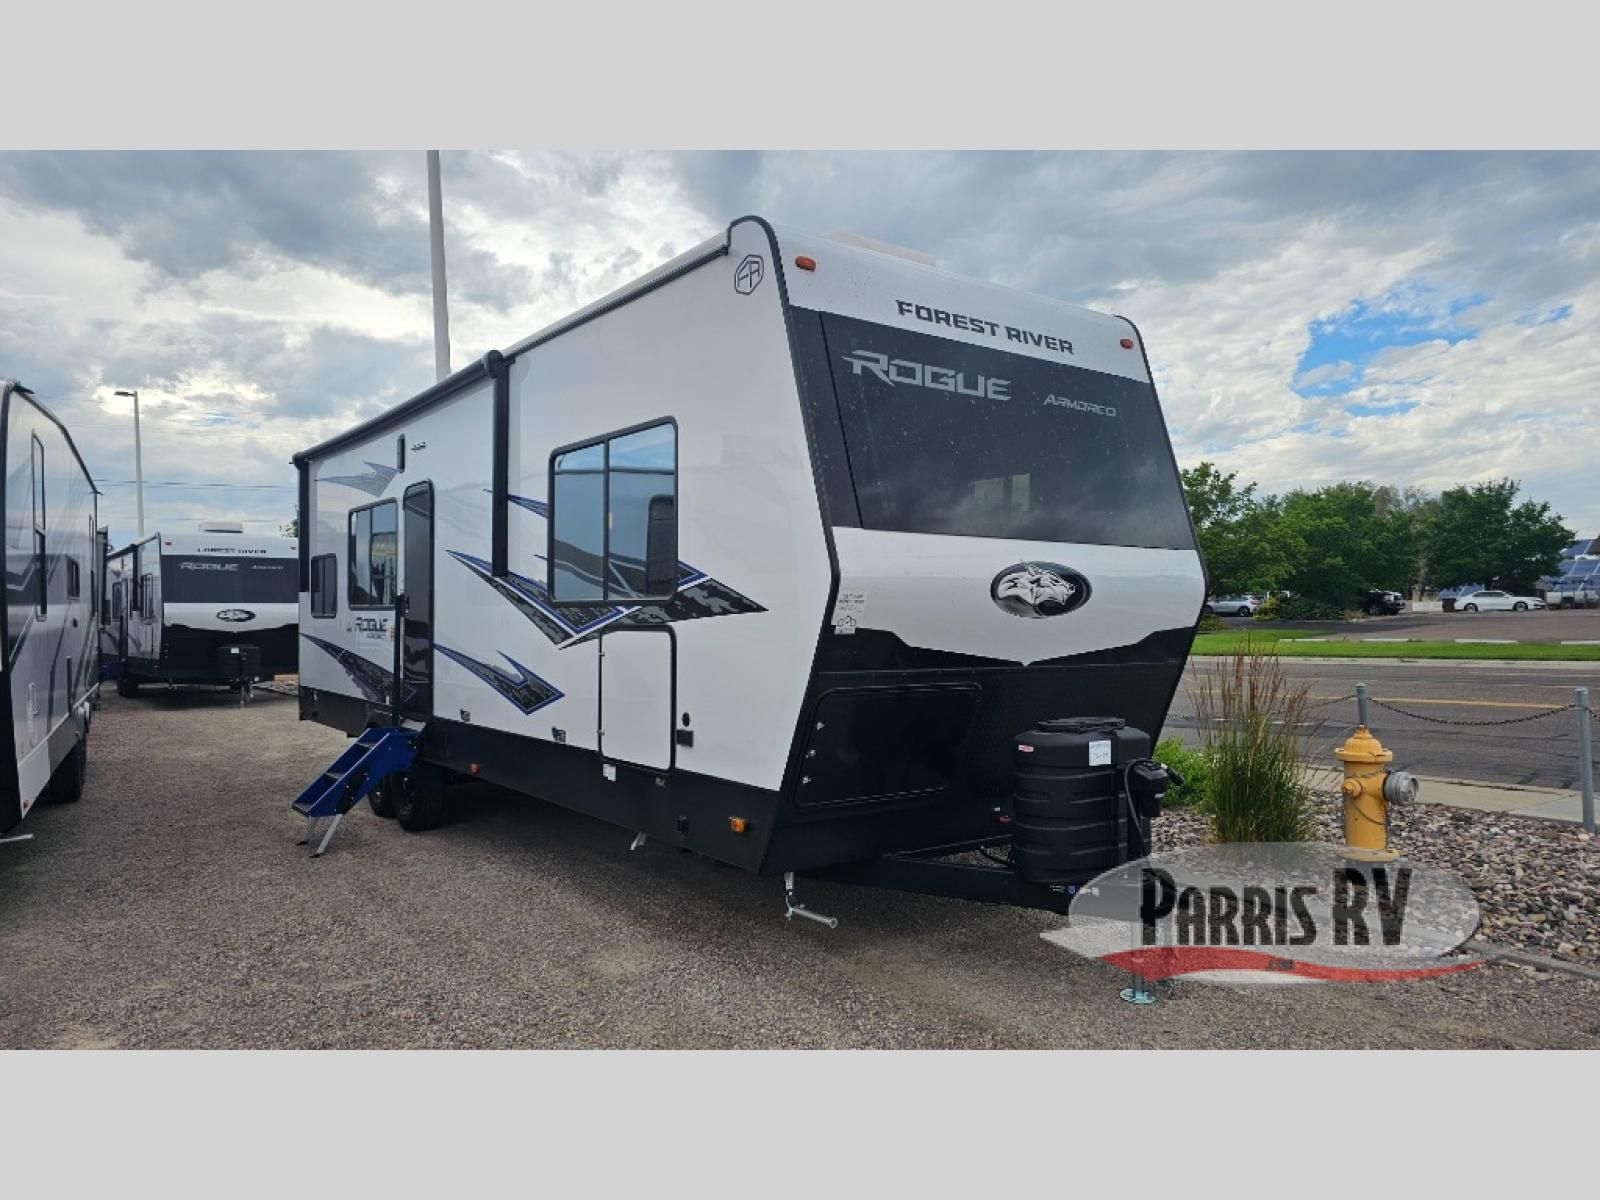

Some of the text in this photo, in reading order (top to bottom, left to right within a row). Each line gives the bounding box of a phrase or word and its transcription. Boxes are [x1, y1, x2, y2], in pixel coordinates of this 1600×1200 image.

[895, 299, 1074, 355] FOREST RIVER
[841, 349, 1116, 417] ROGUE ARMORED
